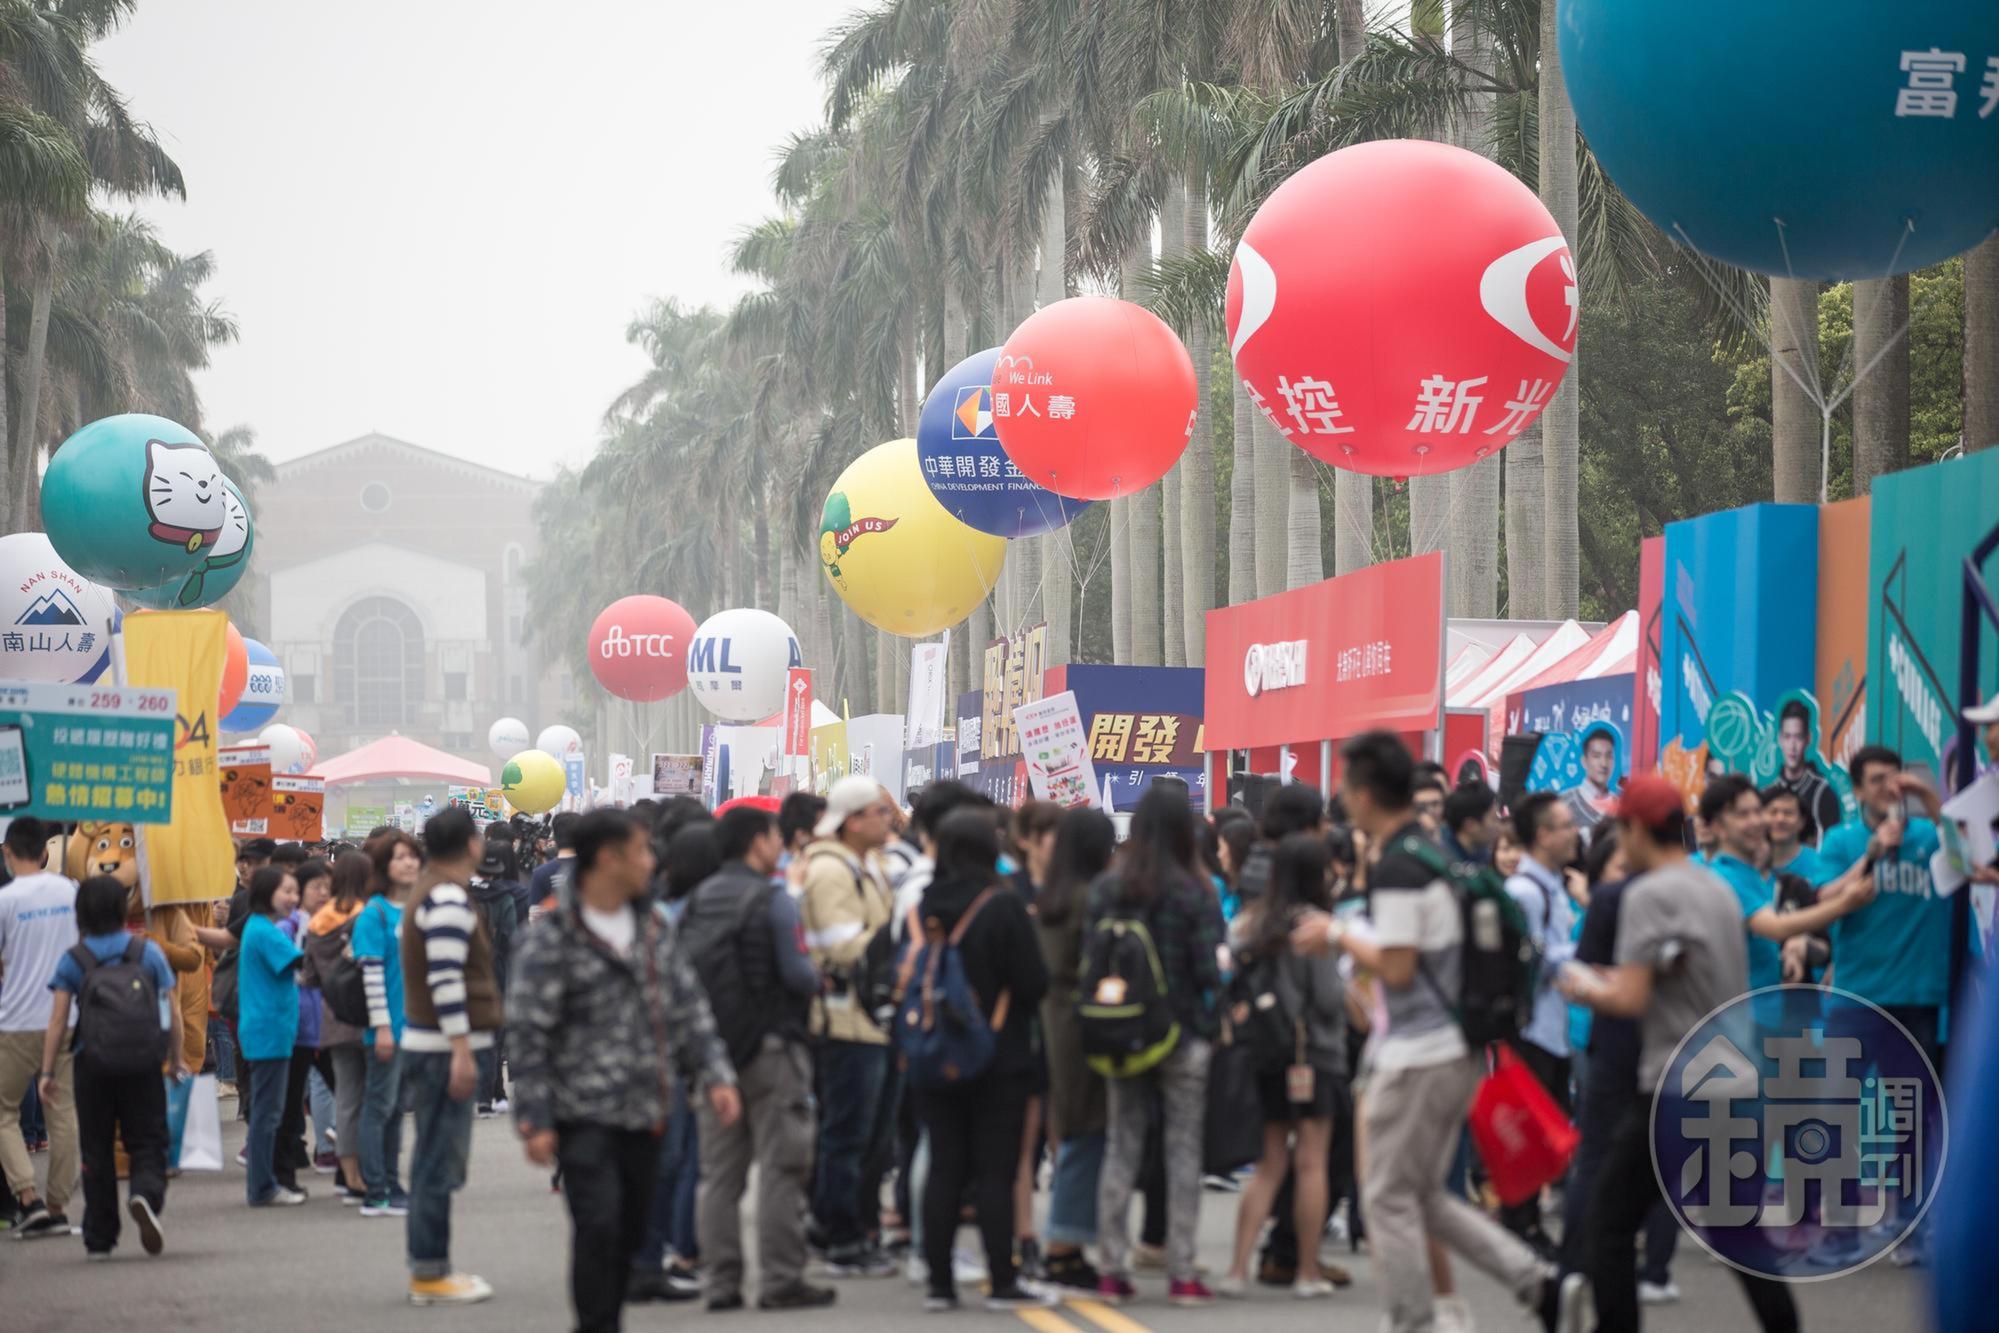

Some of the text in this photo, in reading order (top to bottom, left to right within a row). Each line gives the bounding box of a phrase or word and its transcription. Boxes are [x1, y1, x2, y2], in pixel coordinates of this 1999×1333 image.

[1009, 371, 1053, 386] We Link
[991, 393, 1076, 420] 國人壽
[1404, 374, 1553, 436] 新光
[1008, 482, 1045, 490] FINANC
[838, 521, 882, 544] JOIN US
[20, 570, 82, 594] NAN SHAN
[2, 631, 96, 654] 南山人壽
[630, 634, 674, 657] TCC
[91, 692, 121, 709] 259
[138, 695, 168, 711] 260
[1086, 713, 1205, 763] 開發
